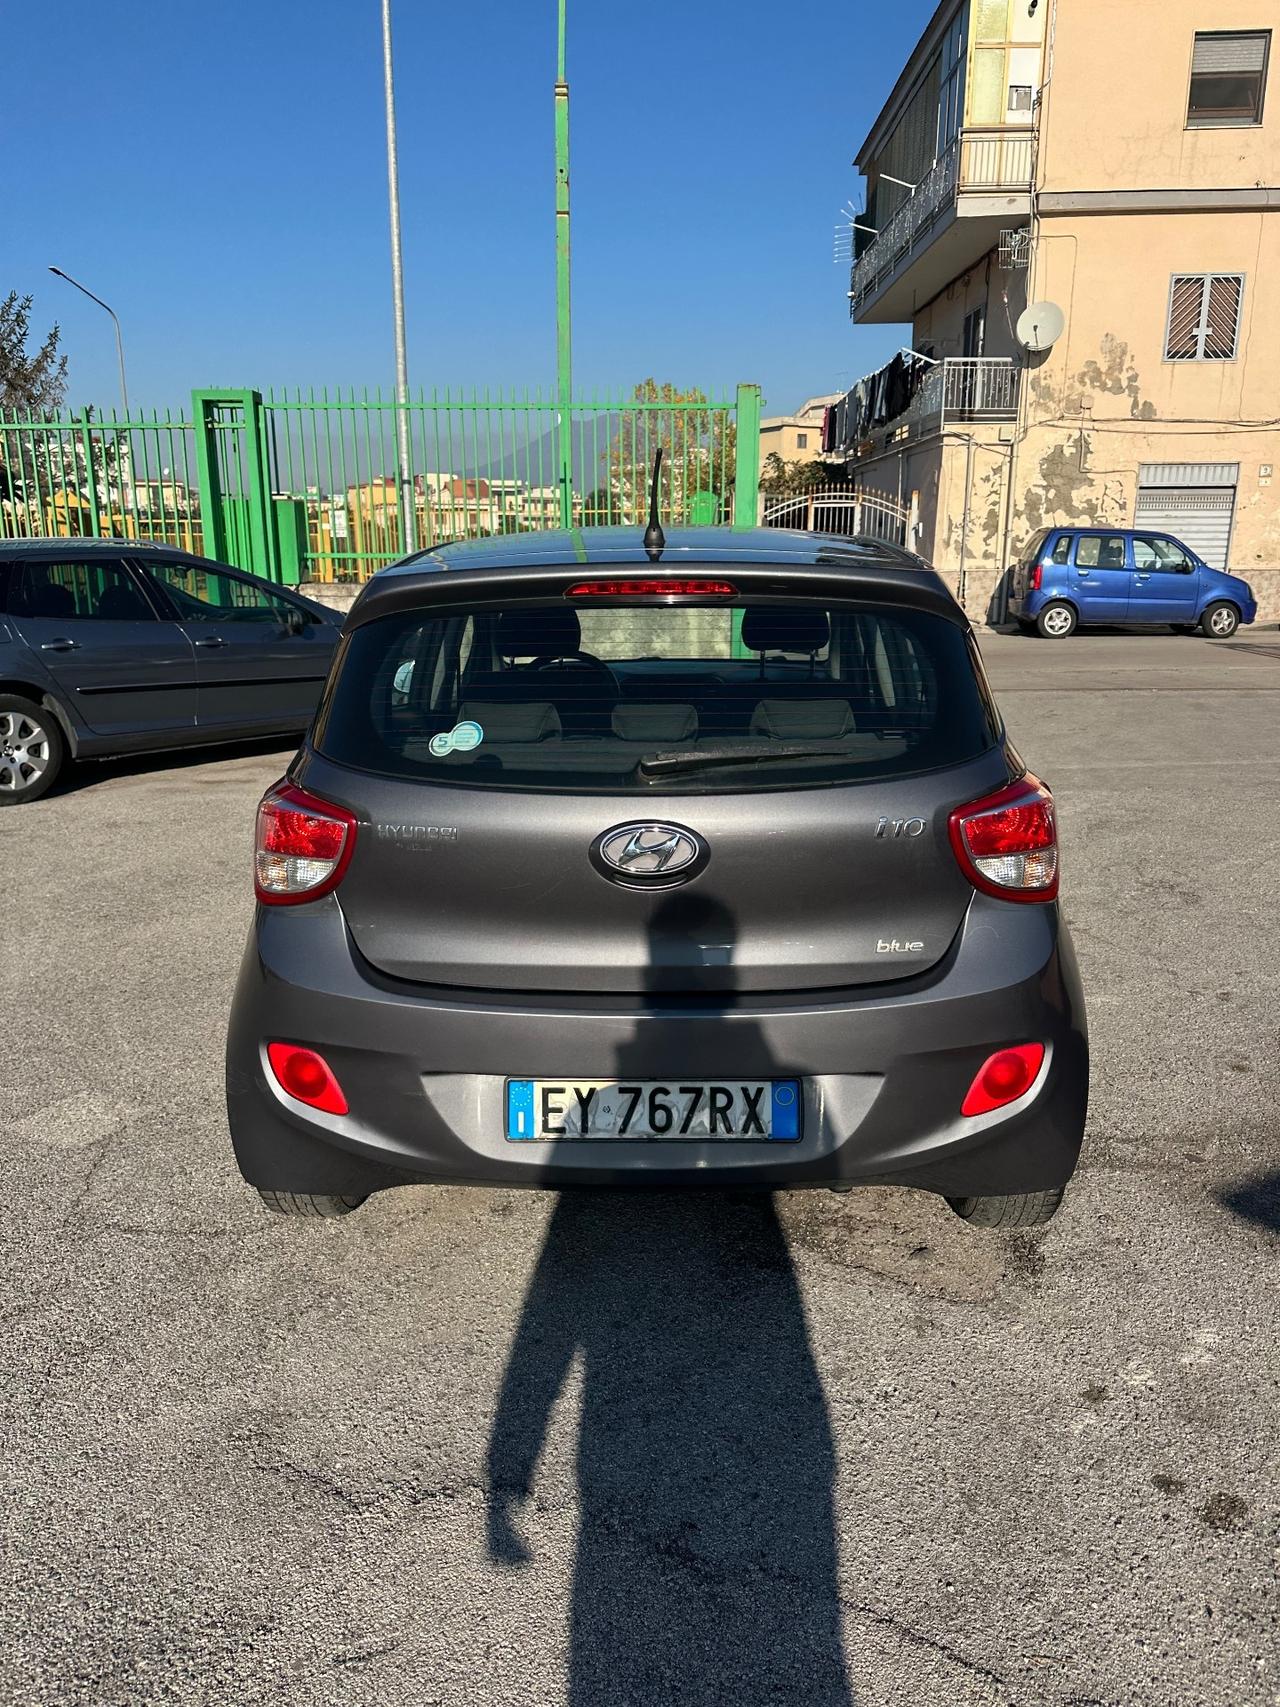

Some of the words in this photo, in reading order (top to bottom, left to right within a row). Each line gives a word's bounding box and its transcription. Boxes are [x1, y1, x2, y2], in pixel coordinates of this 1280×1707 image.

[438, 736, 449, 746] 5
[377, 824, 458, 840] HYUNDAI
[874, 816, 926, 838] i10
[876, 939, 924, 952] blue
[541, 1087, 597, 1134] EY
[618, 1086, 765, 1135] 767RX
